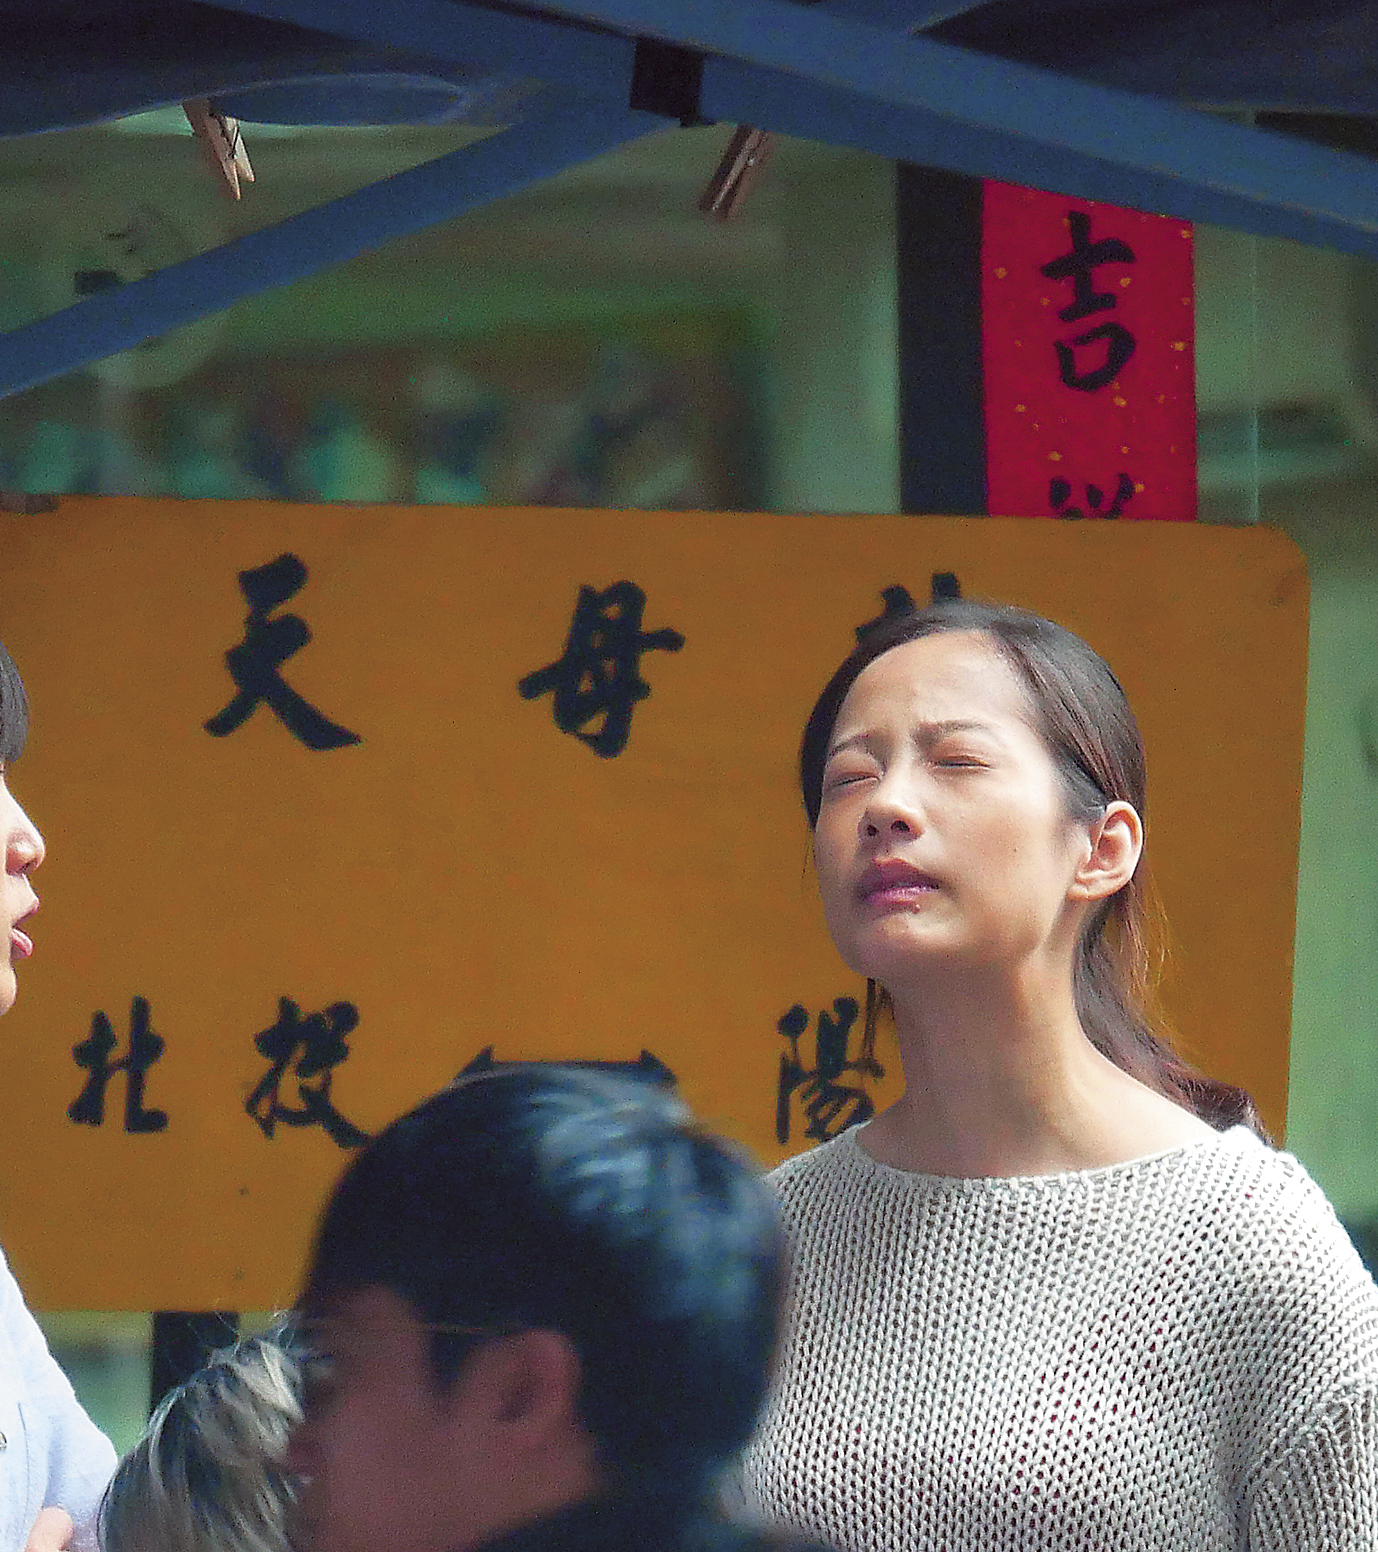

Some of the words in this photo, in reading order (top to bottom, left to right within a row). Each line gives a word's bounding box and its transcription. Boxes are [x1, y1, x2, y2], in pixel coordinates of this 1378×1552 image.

[1040, 210, 1137, 520] 吉
[204, 552, 962, 758] 天母
[68, 993, 372, 1149] 北投
